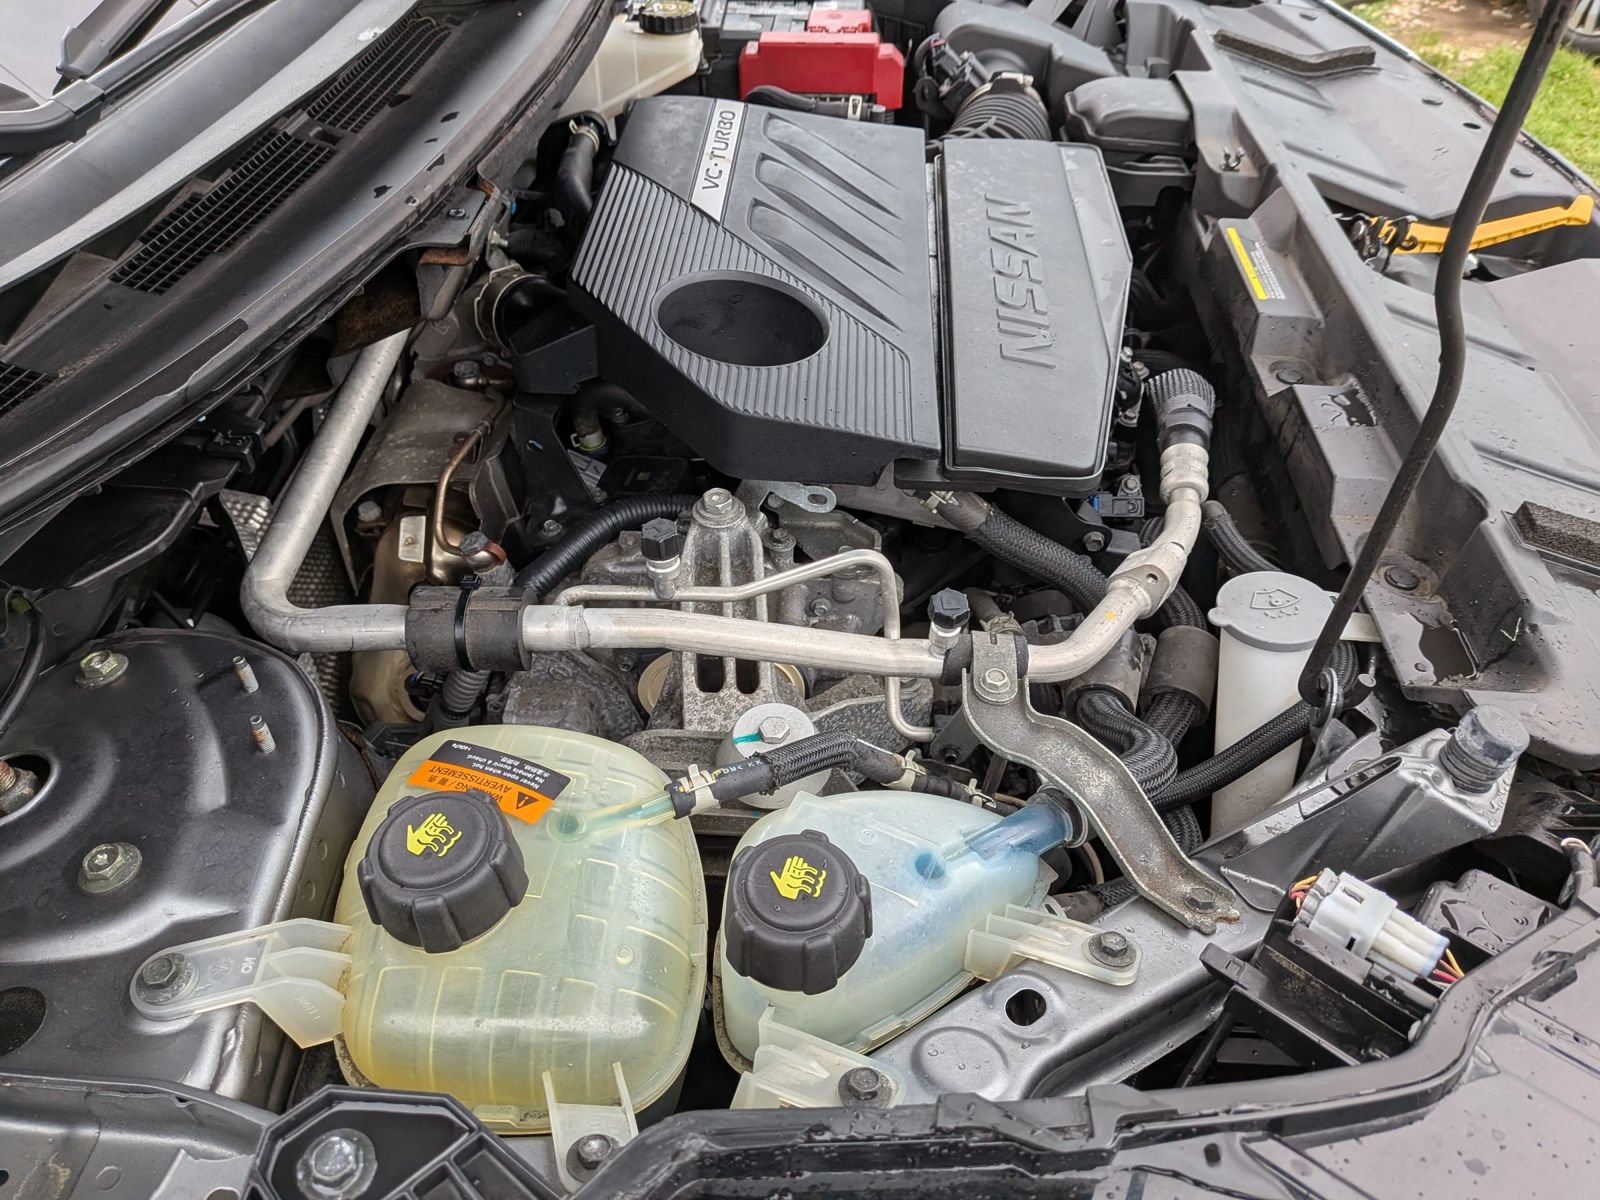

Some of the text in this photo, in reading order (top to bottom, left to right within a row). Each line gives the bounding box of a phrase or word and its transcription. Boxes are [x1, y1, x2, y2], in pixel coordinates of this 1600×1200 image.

[984, 193, 1057, 369] NISSAN
[484, 766, 502, 774] when
[502, 771, 520, 780] open
[429, 765, 513, 793] AVERTISSEMENT
[520, 778, 540, 789] Never
